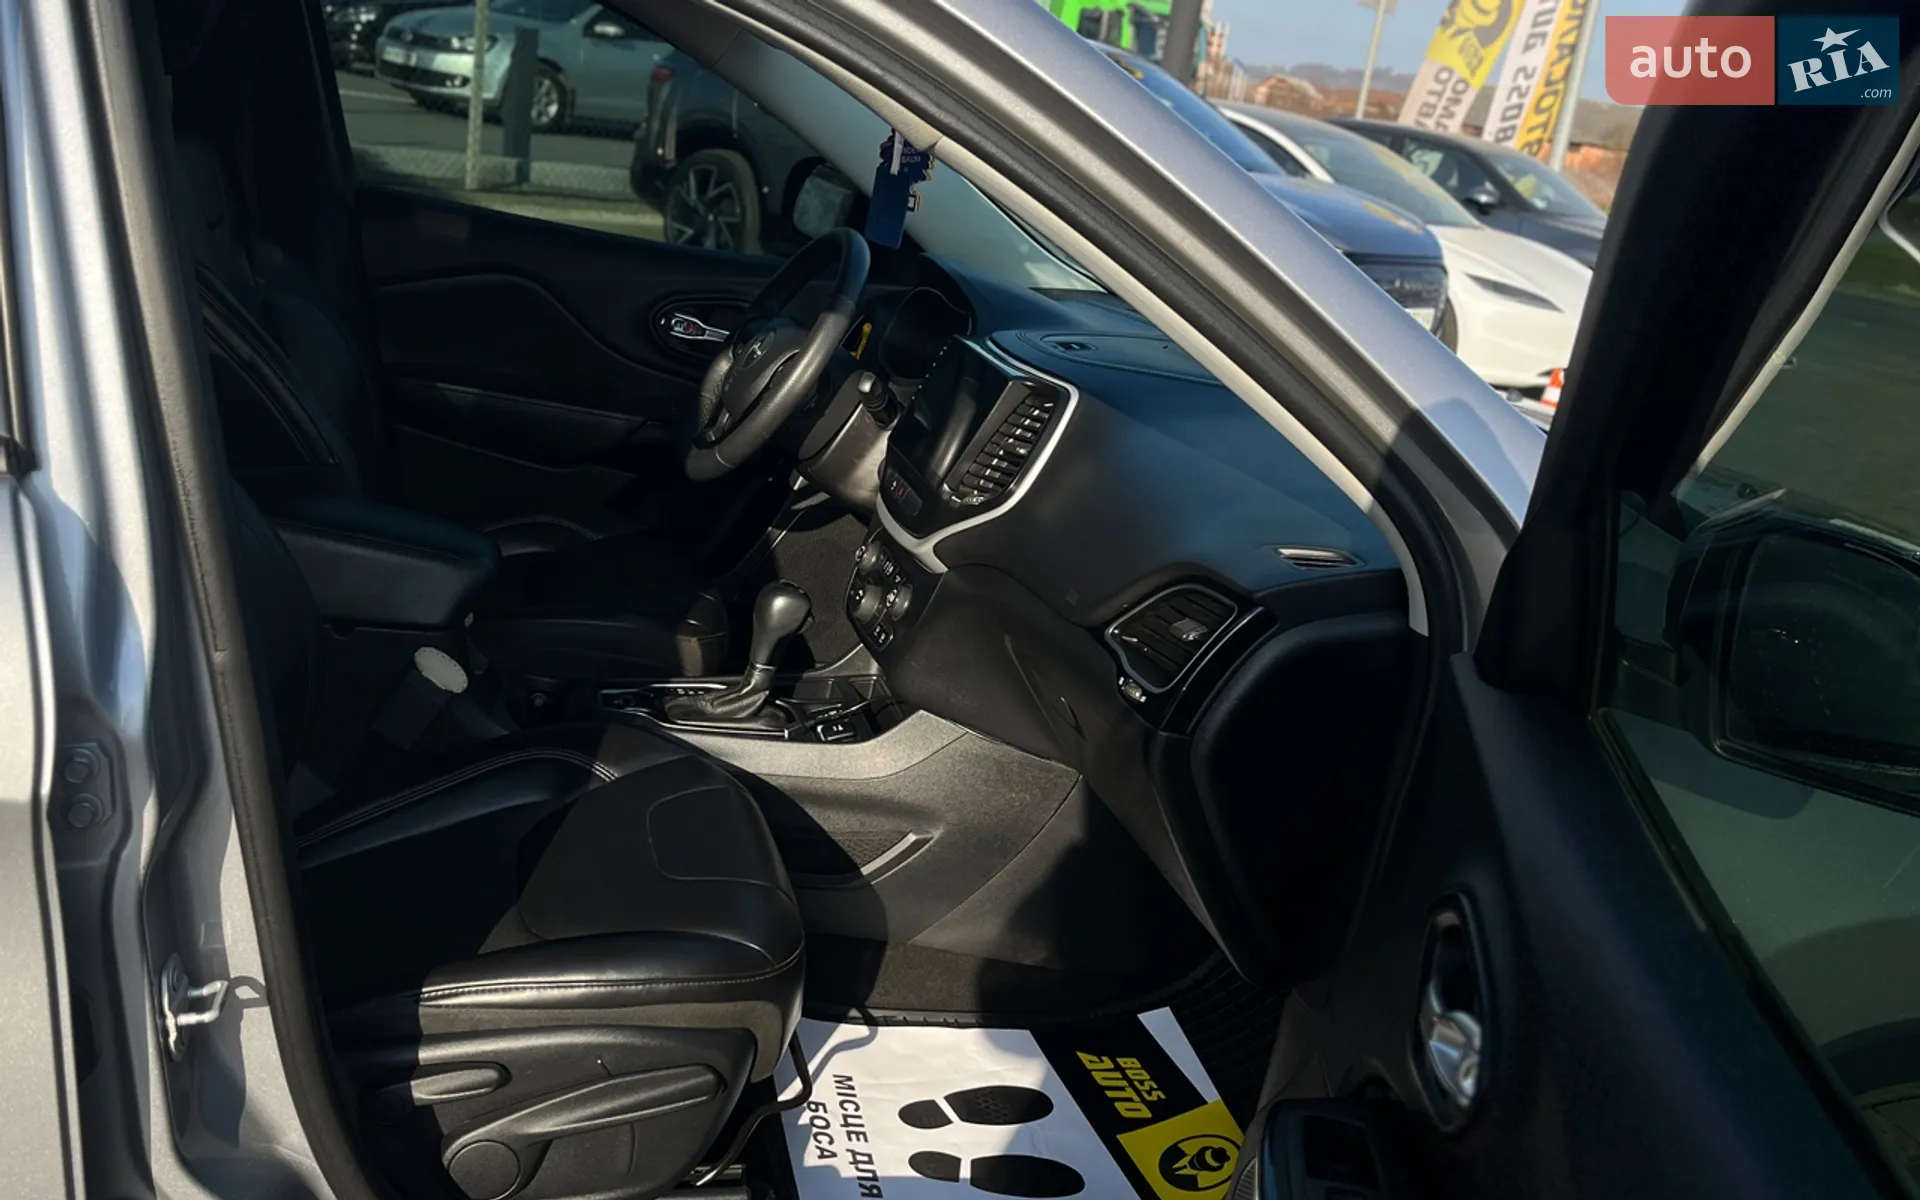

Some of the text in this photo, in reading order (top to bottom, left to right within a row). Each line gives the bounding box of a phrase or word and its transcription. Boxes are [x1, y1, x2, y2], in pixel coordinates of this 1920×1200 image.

[1116, 1057, 1167, 1101] BOSS
[805, 1100, 838, 1160] БОСА
[832, 1073, 884, 1199] МІСЦЕ ДЛЯ
